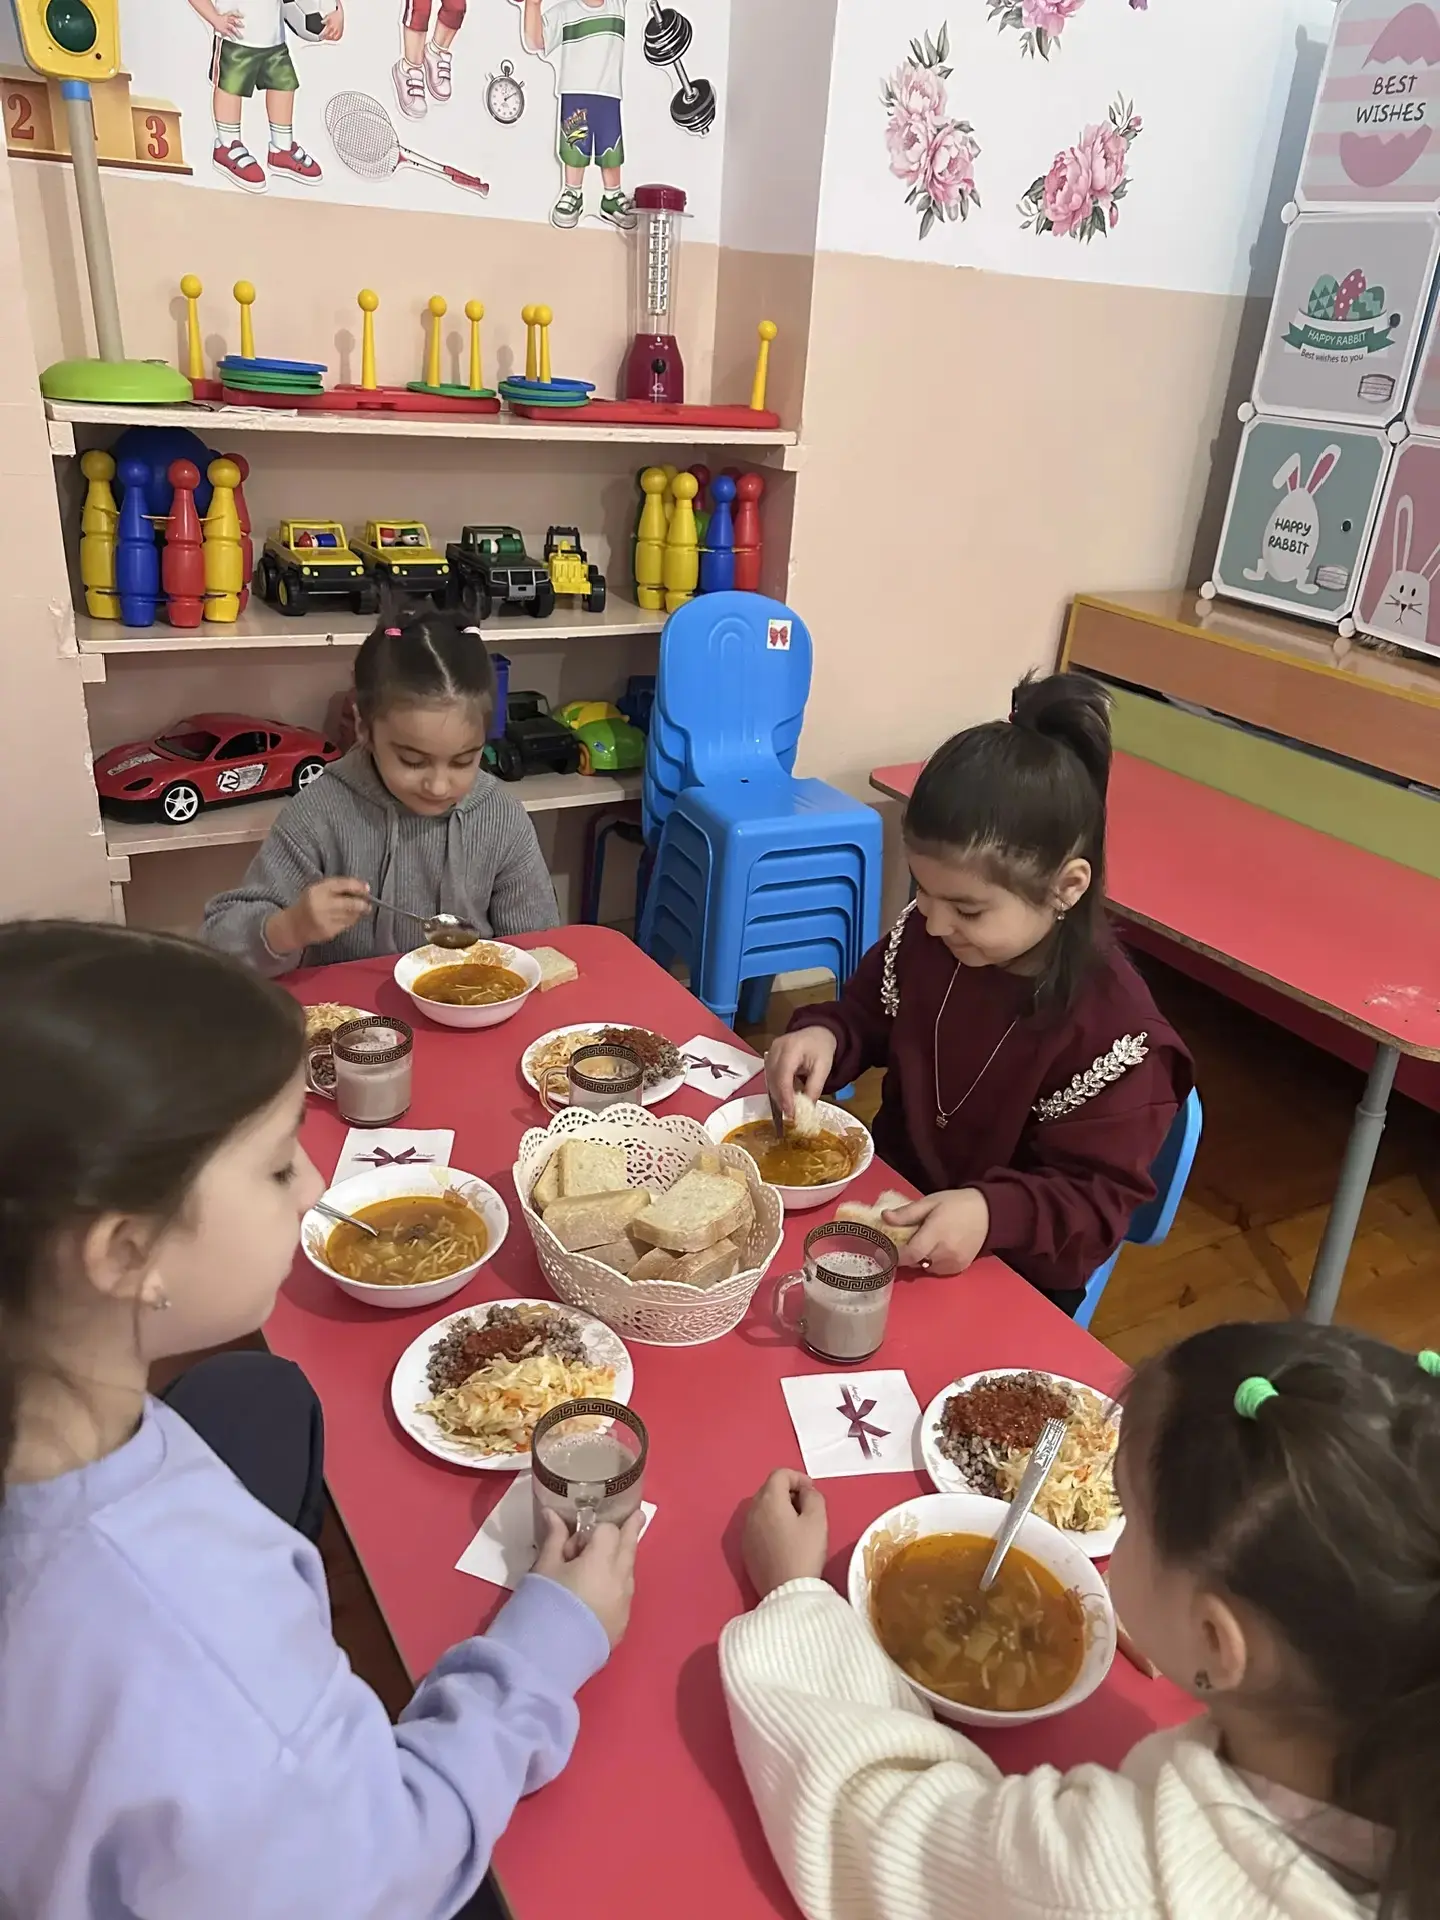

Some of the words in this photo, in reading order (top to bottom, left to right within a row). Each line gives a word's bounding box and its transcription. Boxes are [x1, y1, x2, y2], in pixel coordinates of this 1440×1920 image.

[1372, 74, 1418, 95] BEST
[7, 93, 34, 140] 2
[1356, 102, 1426, 123] WISHES
[145, 115, 169, 159] 3
[1307, 330, 1335, 345] HAPPY
[1336, 331, 1366, 345] RABBIT
[1300, 349, 1315, 360] Best
[1340, 355, 1348, 363] to
[1350, 353, 1364, 364] you
[1275, 518, 1312, 537] HAPPY
[1268, 535, 1309, 555] RABBIT
